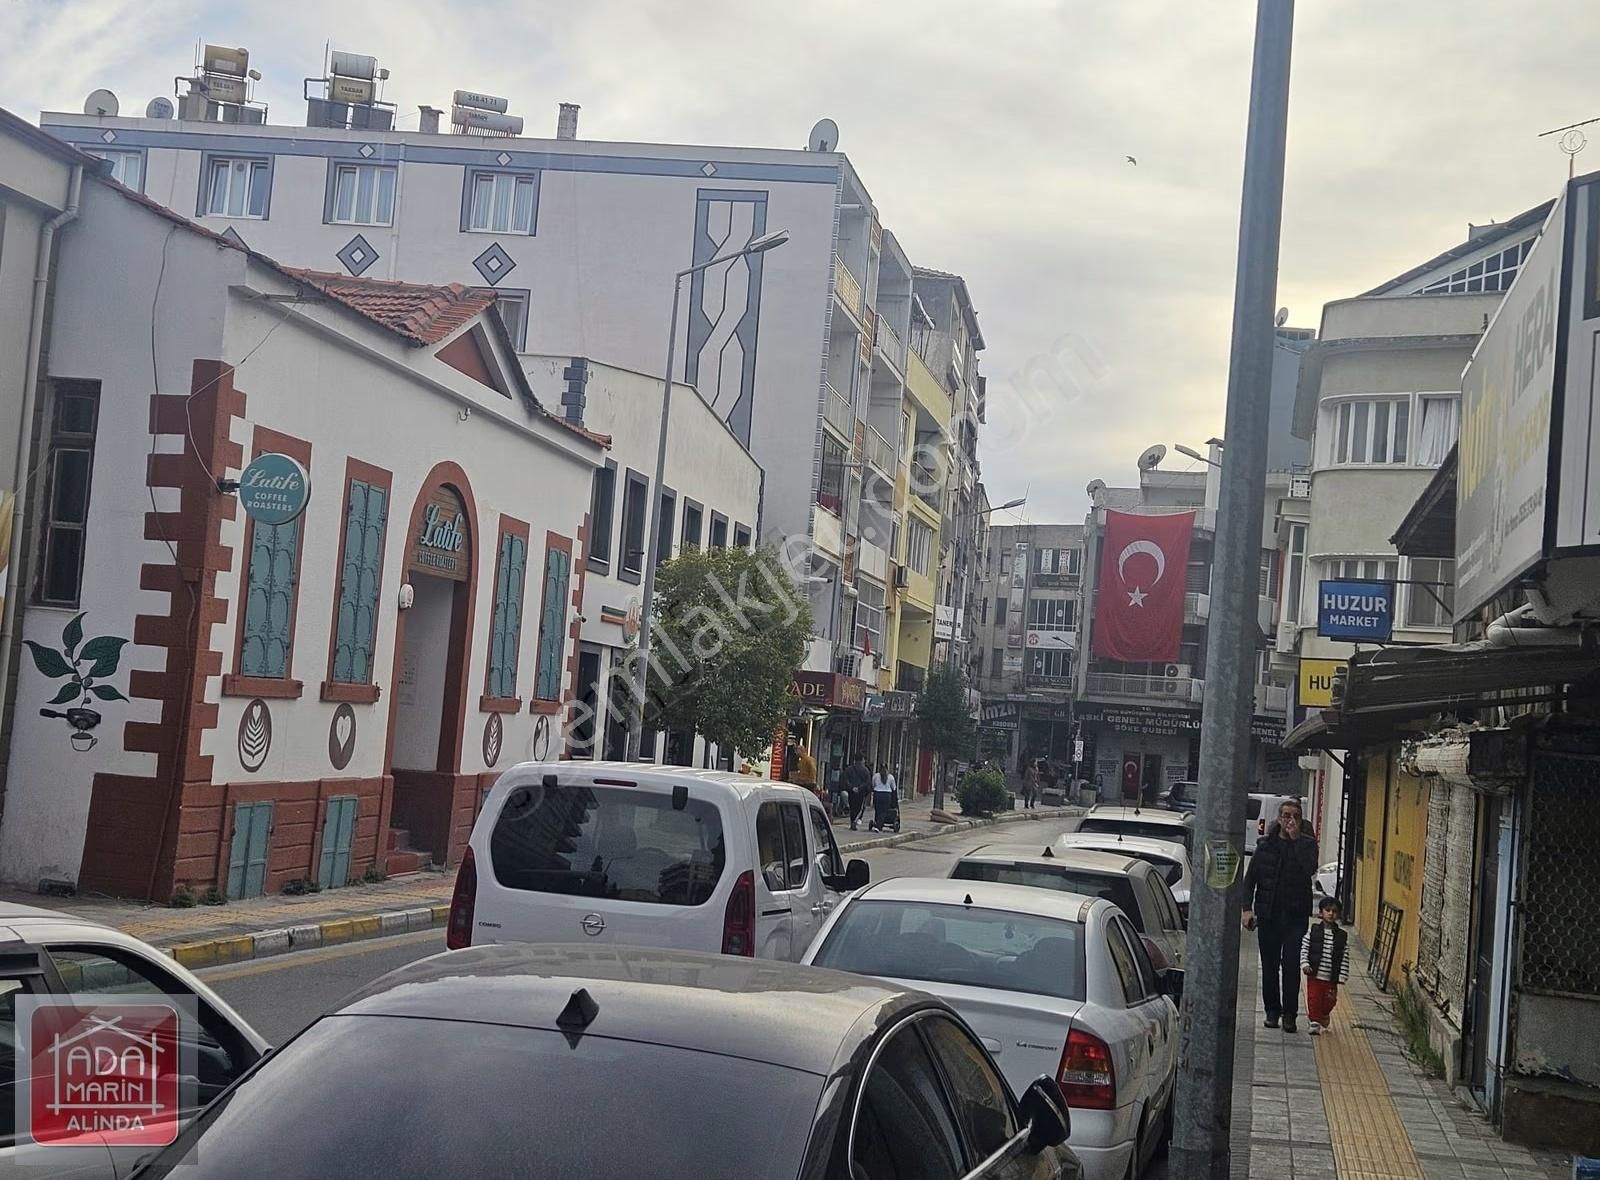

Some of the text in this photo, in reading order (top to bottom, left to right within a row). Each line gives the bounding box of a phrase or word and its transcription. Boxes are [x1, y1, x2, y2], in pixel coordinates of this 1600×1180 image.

[1513, 269, 1555, 403] HERA
[254, 491, 288, 502] COFFEE
[247, 500, 293, 512] ROASTERS
[420, 503, 465, 552] Latife
[1323, 593, 1387, 613] HUZUR
[1329, 614, 1379, 628] MARKET
[1309, 674, 1333, 691] HU
[1107, 713, 1143, 726] GENEL
[1144, 716, 1202, 730] MÜDÜRLÜ
